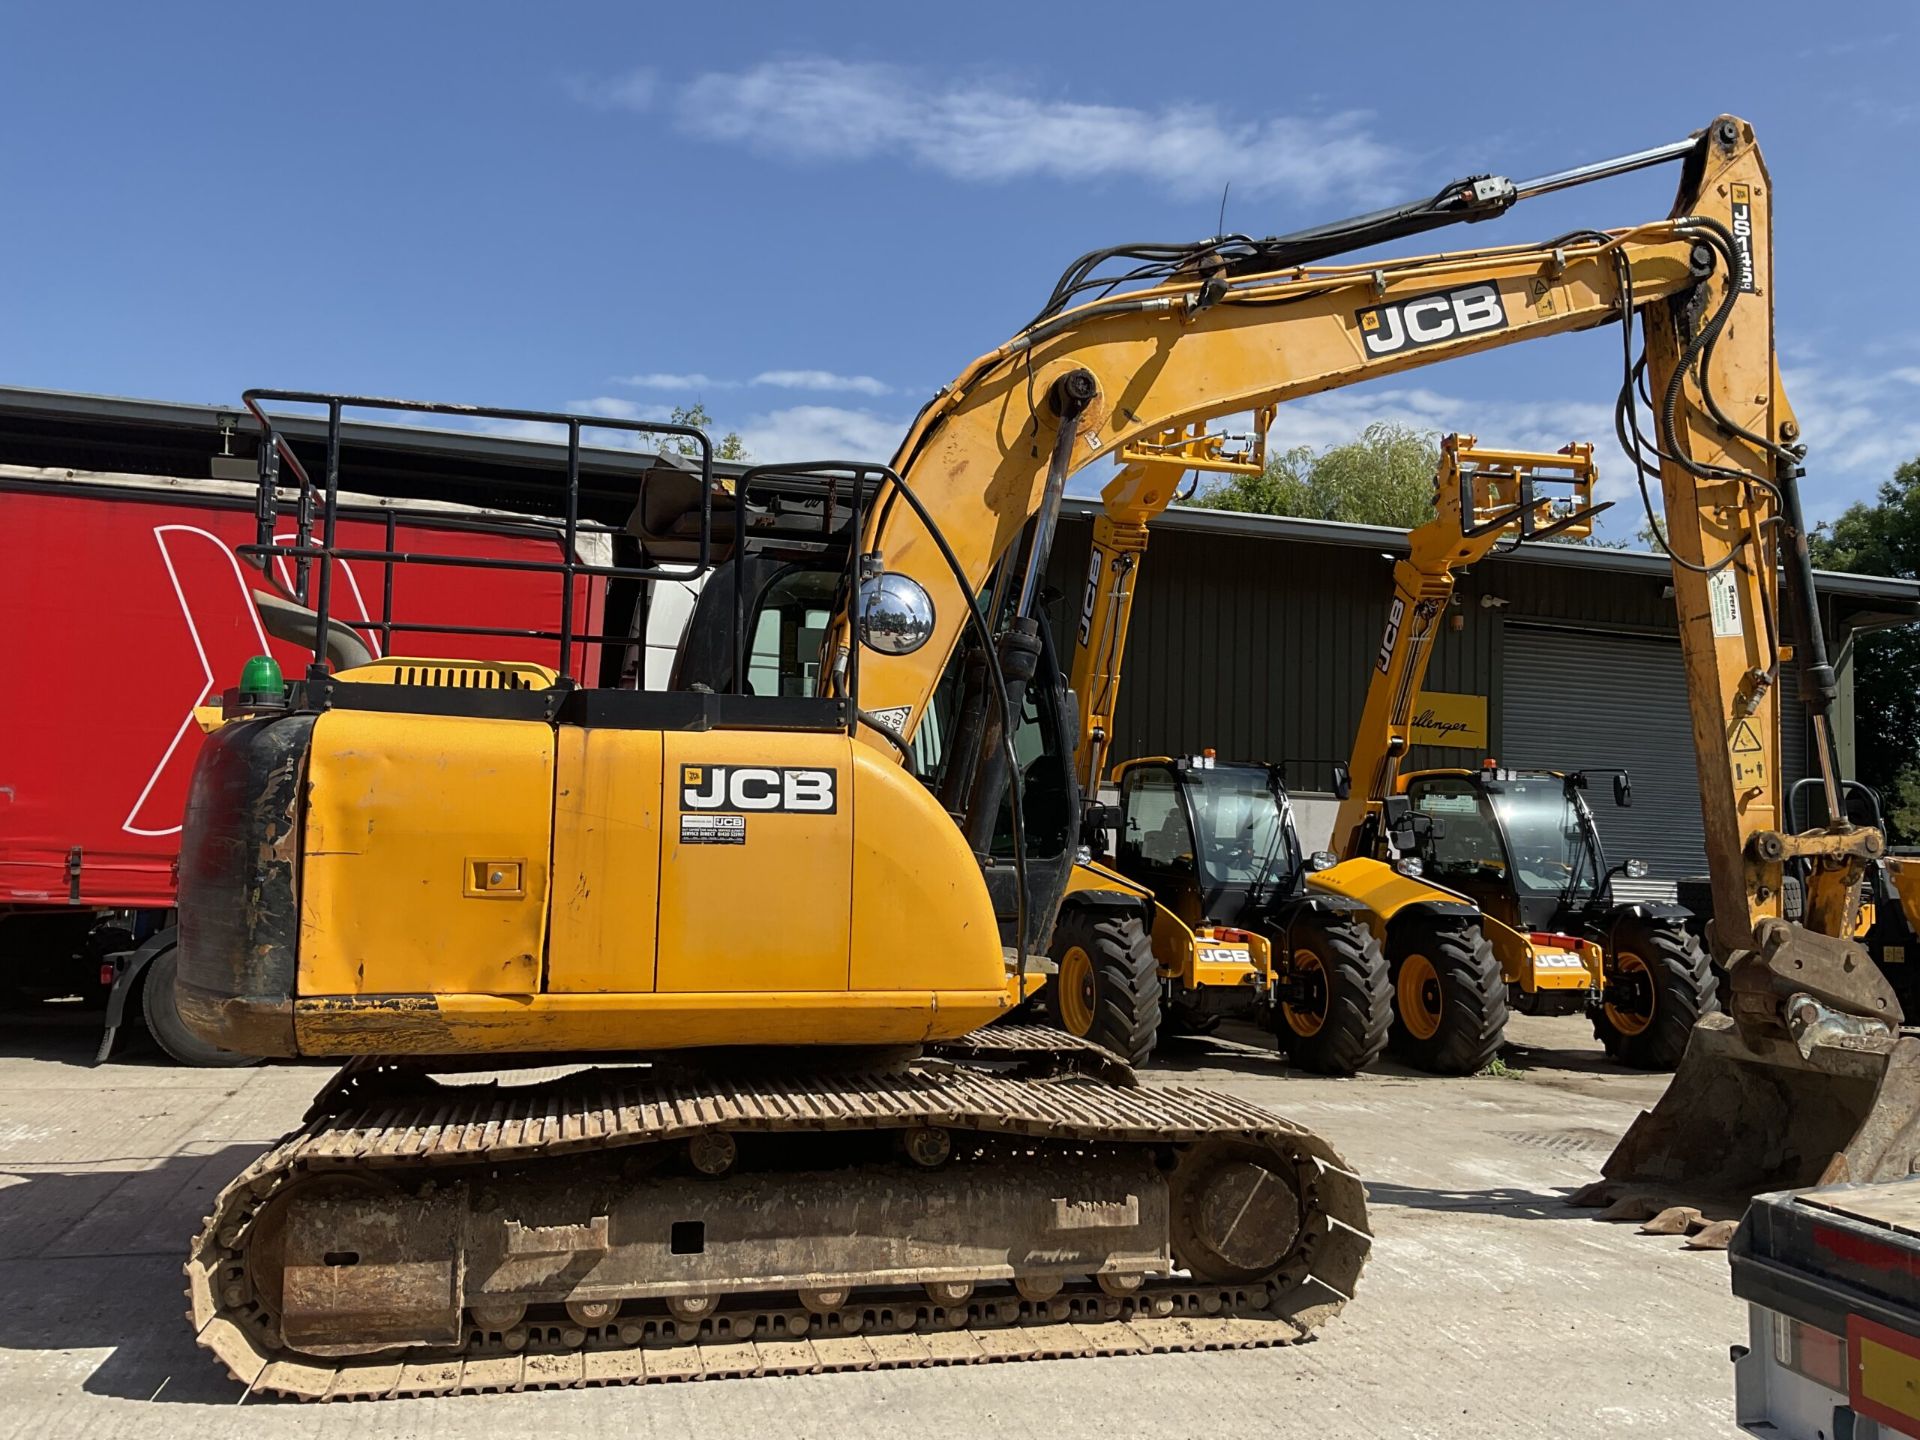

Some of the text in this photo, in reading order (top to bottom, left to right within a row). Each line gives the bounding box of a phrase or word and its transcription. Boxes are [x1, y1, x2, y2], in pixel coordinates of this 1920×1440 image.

[1366, 285, 1503, 353] JCB
[1082, 550, 1102, 645] JCB
[1380, 598, 1404, 672] JCB
[684, 768, 834, 810] JCB
[716, 818, 742, 826] JCB
[1200, 949, 1251, 962] JCB
[1536, 954, 1582, 967] JCB
